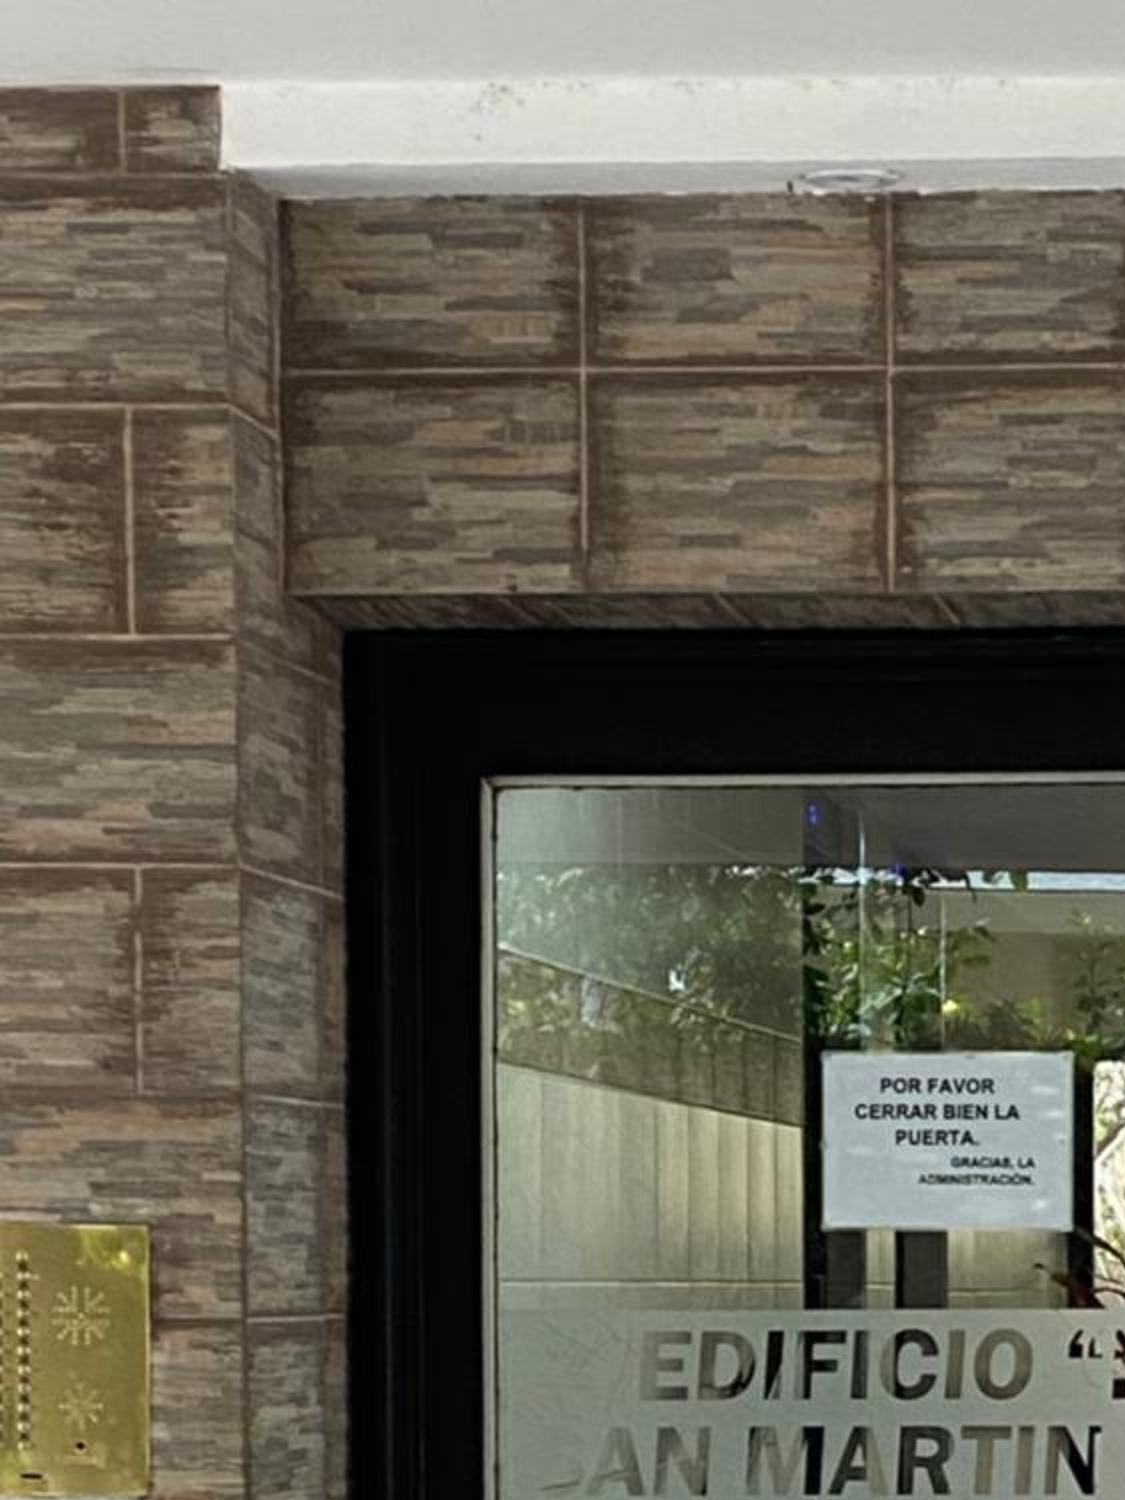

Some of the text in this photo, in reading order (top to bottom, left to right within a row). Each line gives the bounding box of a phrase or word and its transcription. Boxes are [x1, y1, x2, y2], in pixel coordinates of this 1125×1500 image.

[880, 1078, 995, 1094] POR FAVOR
[854, 1104, 1020, 1121] CERRAR BIEN LA
[895, 1130, 981, 1146] PUERTA.
[1017, 1157, 1036, 1168] LA
[646, 1329, 1032, 1401] EDIFICIO
[538, 1426, 711, 1496] AN
[745, 1426, 1103, 1496] MARTIN
